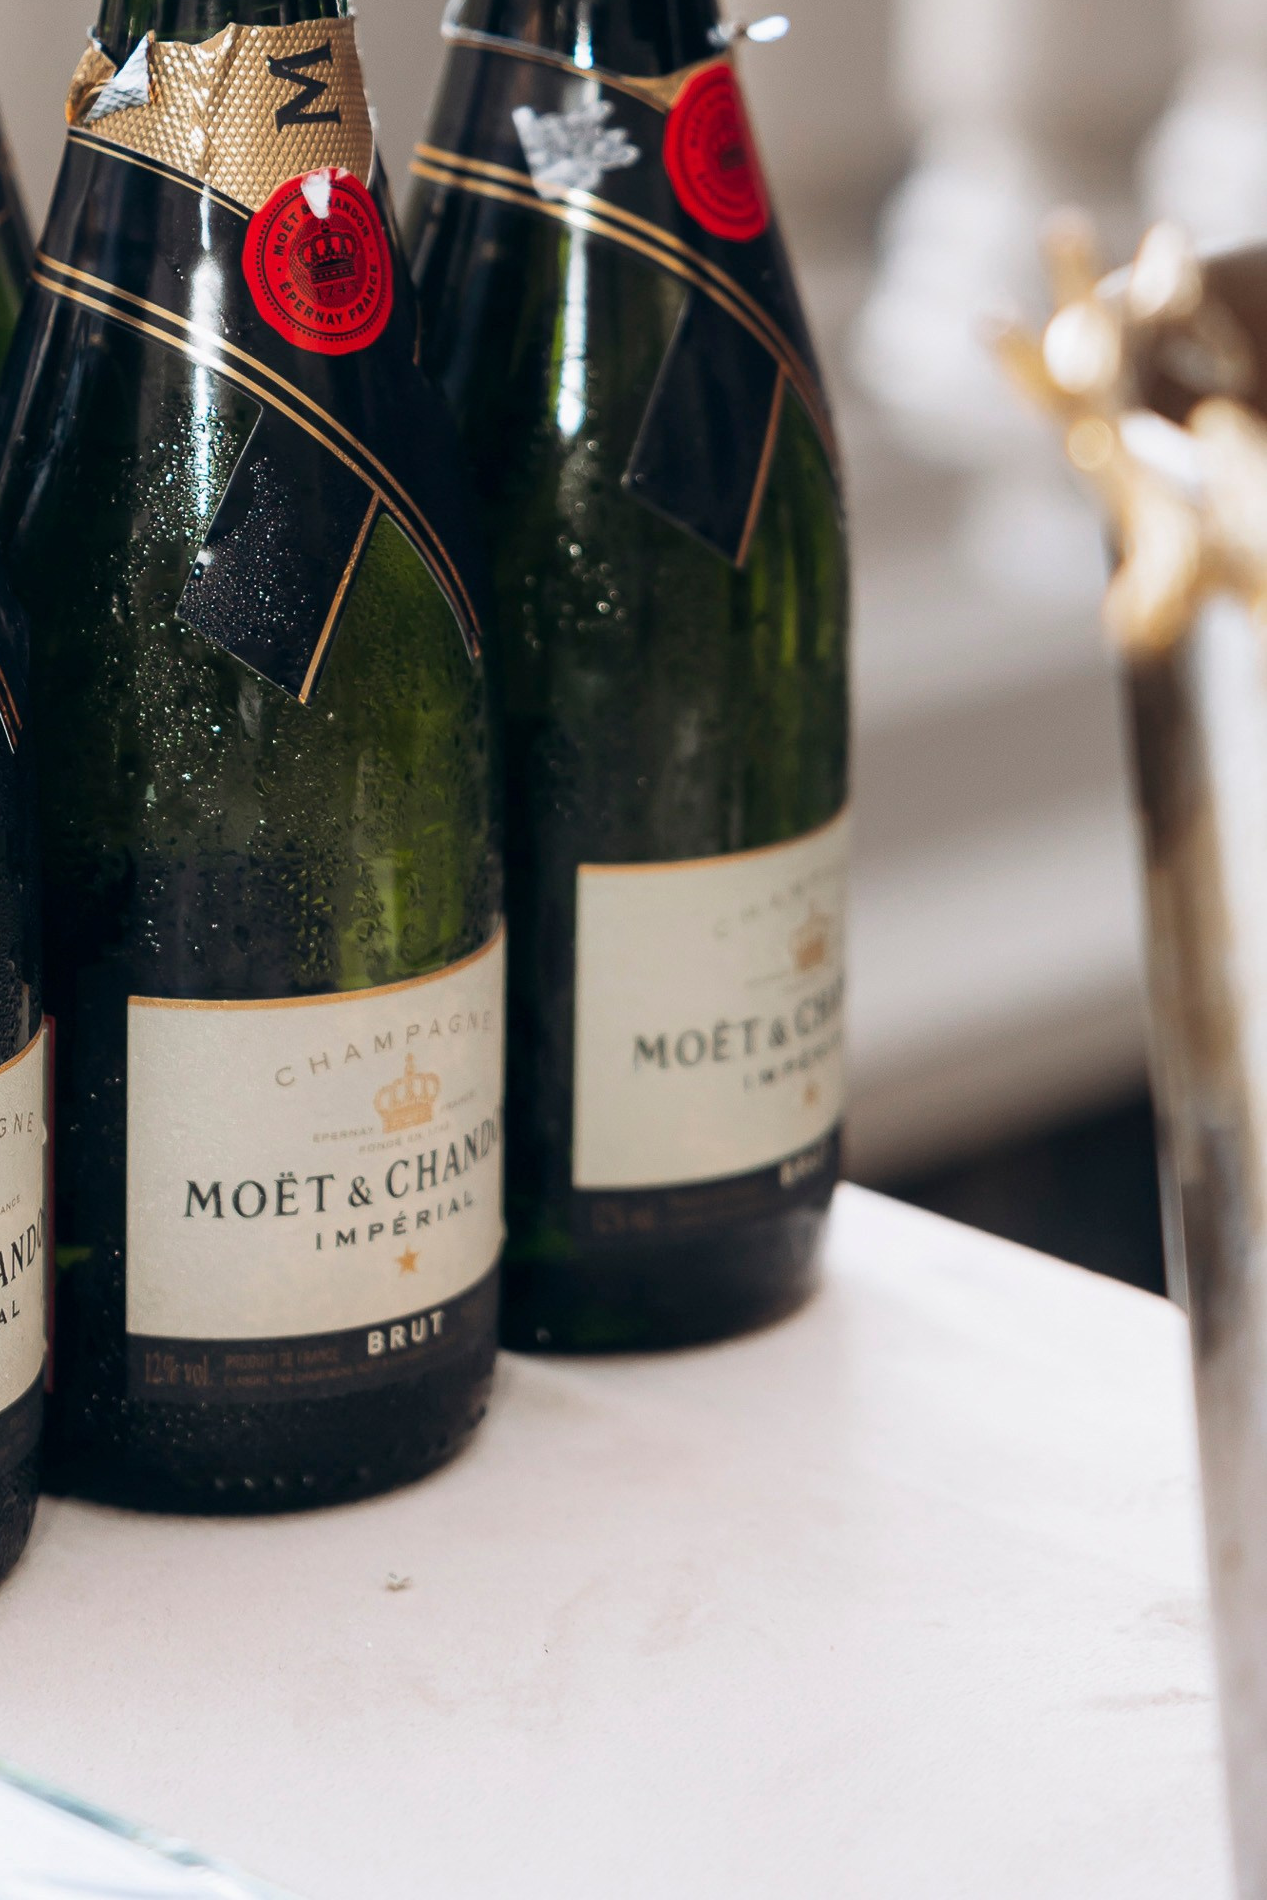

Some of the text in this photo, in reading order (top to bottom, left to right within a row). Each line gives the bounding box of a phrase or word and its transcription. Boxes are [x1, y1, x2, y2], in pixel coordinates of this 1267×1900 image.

[266, 36, 342, 134] M
[348, 263, 379, 321] FRANCE
[274, 1007, 493, 1089] CHAMPAGNE
[182, 1170, 335, 1221] MOËT
[346, 1174, 373, 1208] &
[314, 1189, 474, 1252] IMPÉRIAL
[367, 1309, 446, 1358] BRUT
